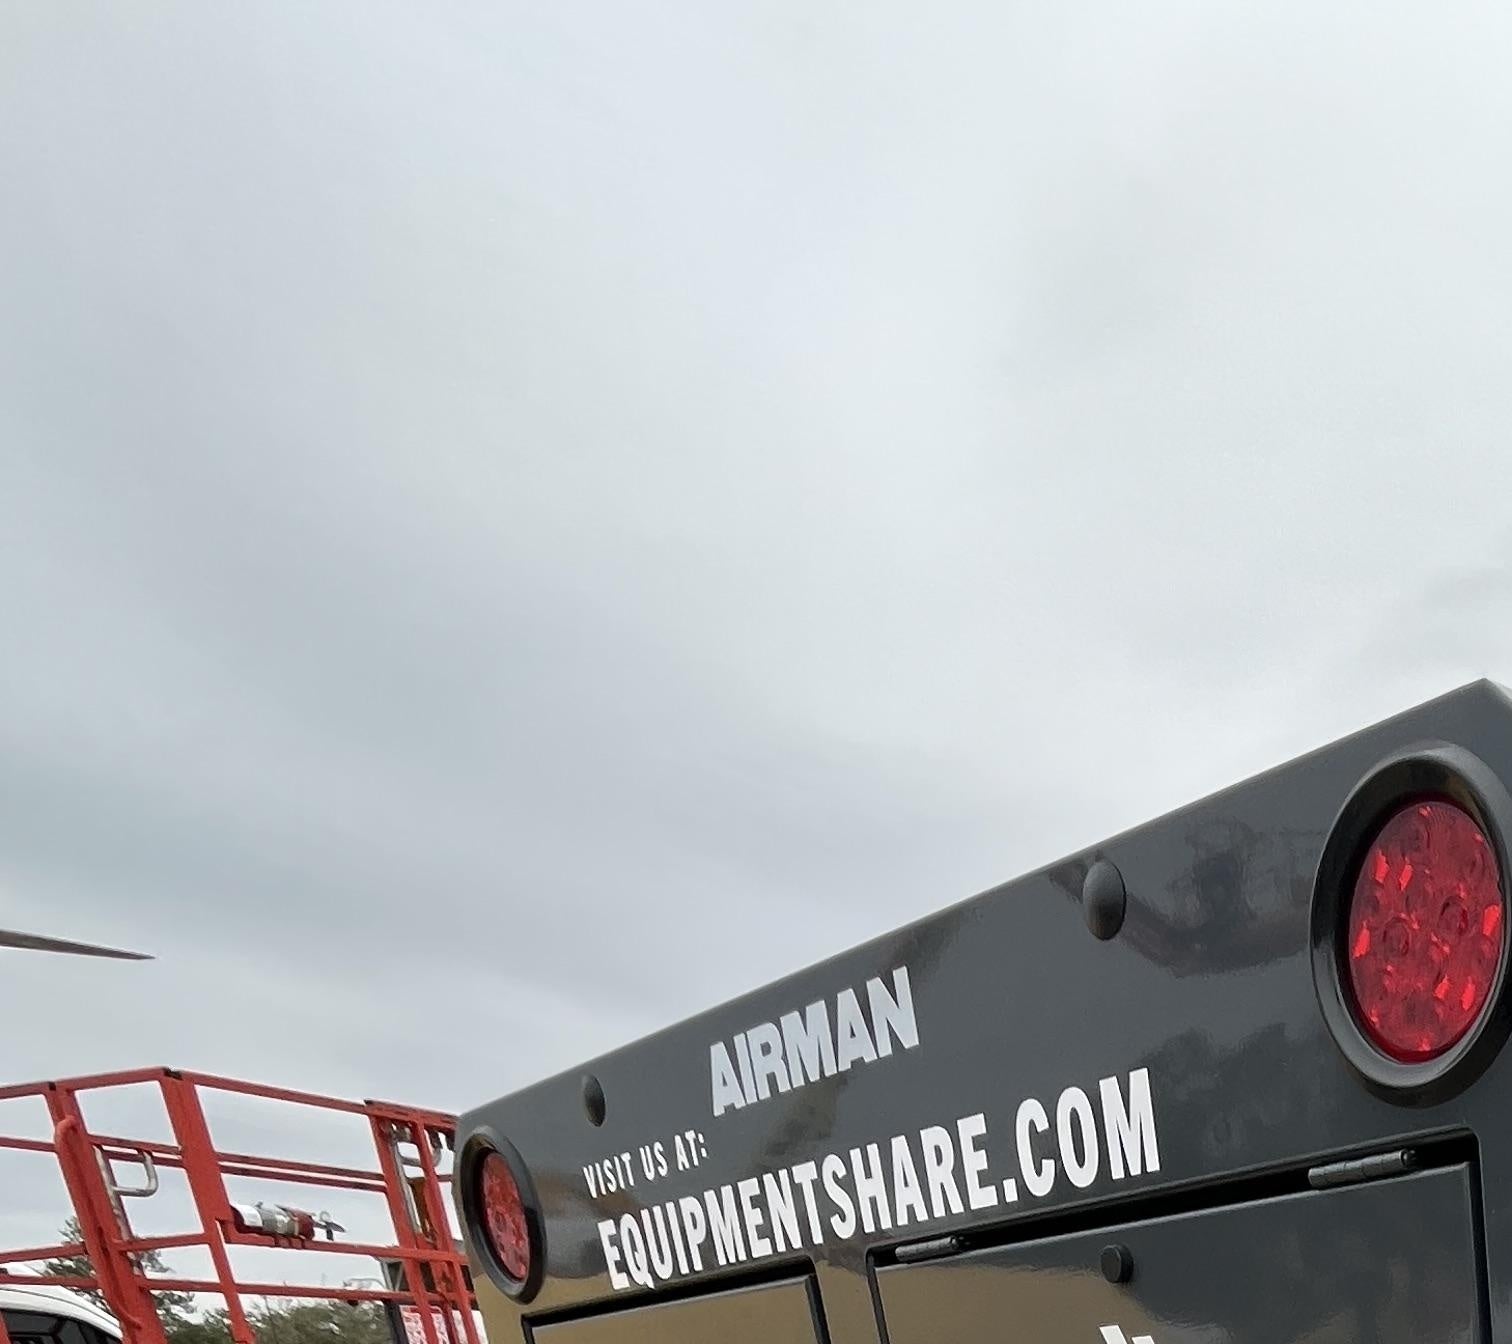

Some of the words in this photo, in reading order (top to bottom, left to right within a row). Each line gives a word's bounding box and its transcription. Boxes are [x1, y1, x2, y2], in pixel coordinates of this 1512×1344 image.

[710, 966, 919, 1117] AIRMAN
[583, 1152, 634, 1199] VISIT
[639, 1141, 668, 1180] US
[674, 1129, 708, 1171] AT:
[598, 1067, 1160, 1291] EQUIPMENTSHARE.COM
